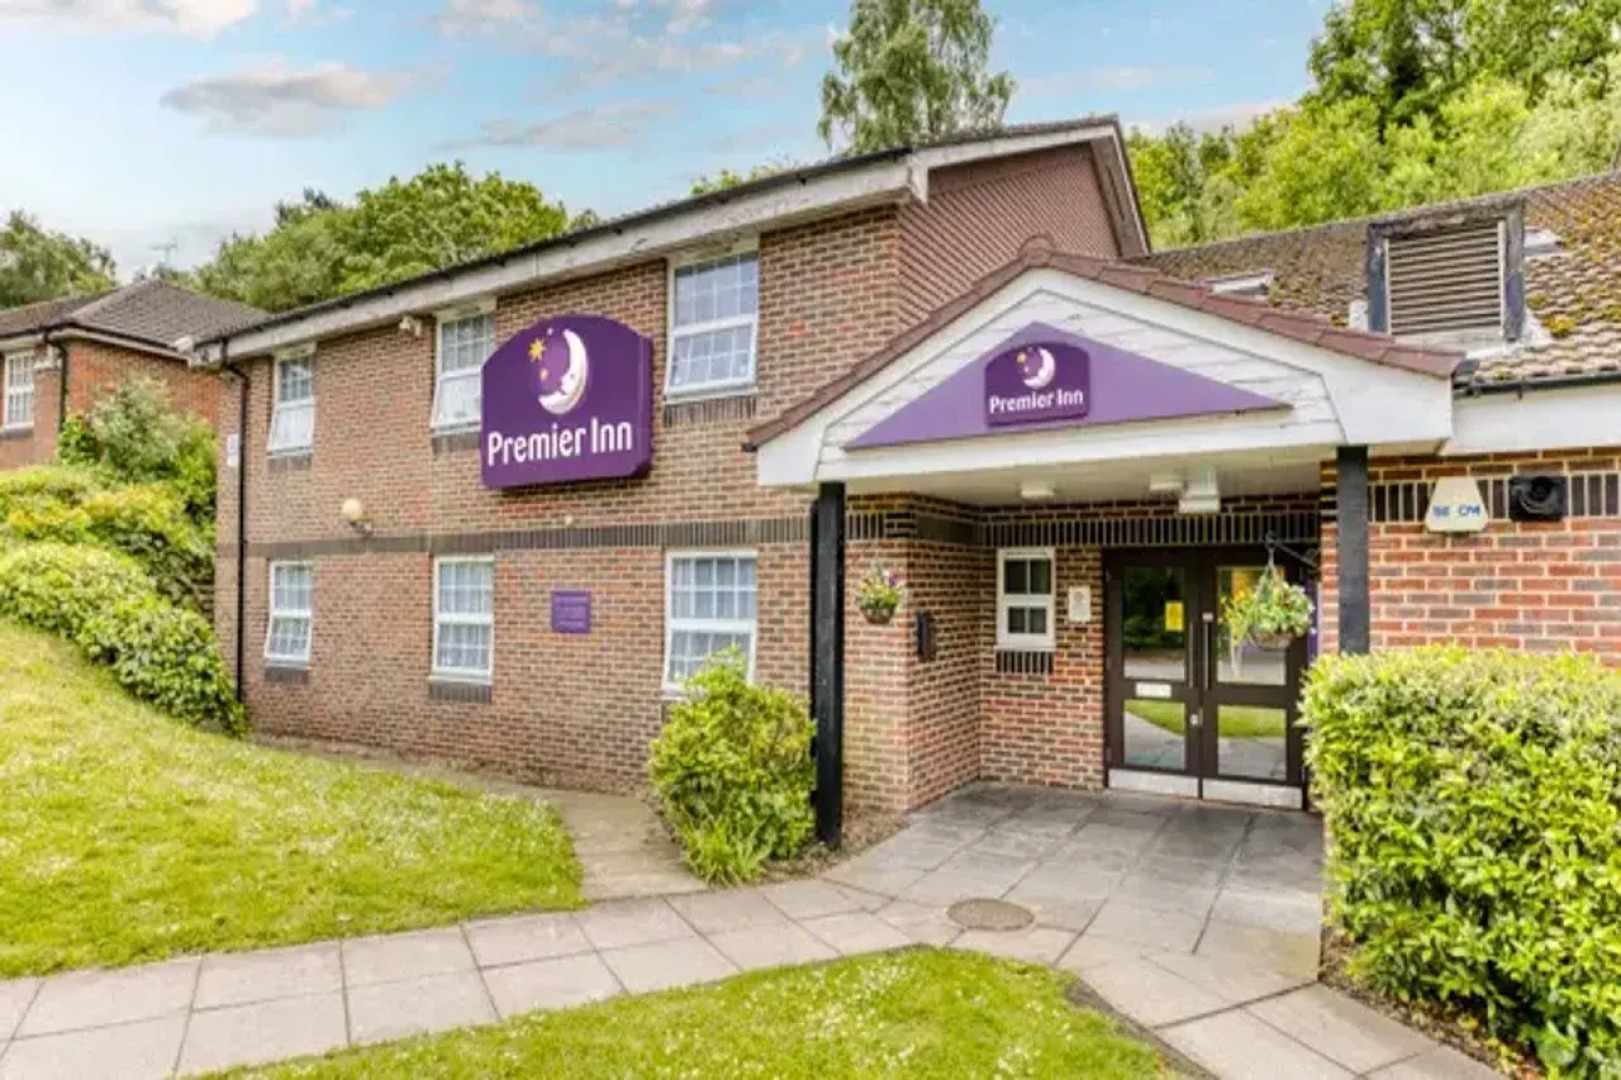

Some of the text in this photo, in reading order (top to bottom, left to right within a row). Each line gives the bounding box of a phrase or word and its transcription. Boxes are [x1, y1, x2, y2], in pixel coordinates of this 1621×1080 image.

[989, 388, 1084, 414] Premier Inn
[487, 417, 632, 467] Premier Inn
